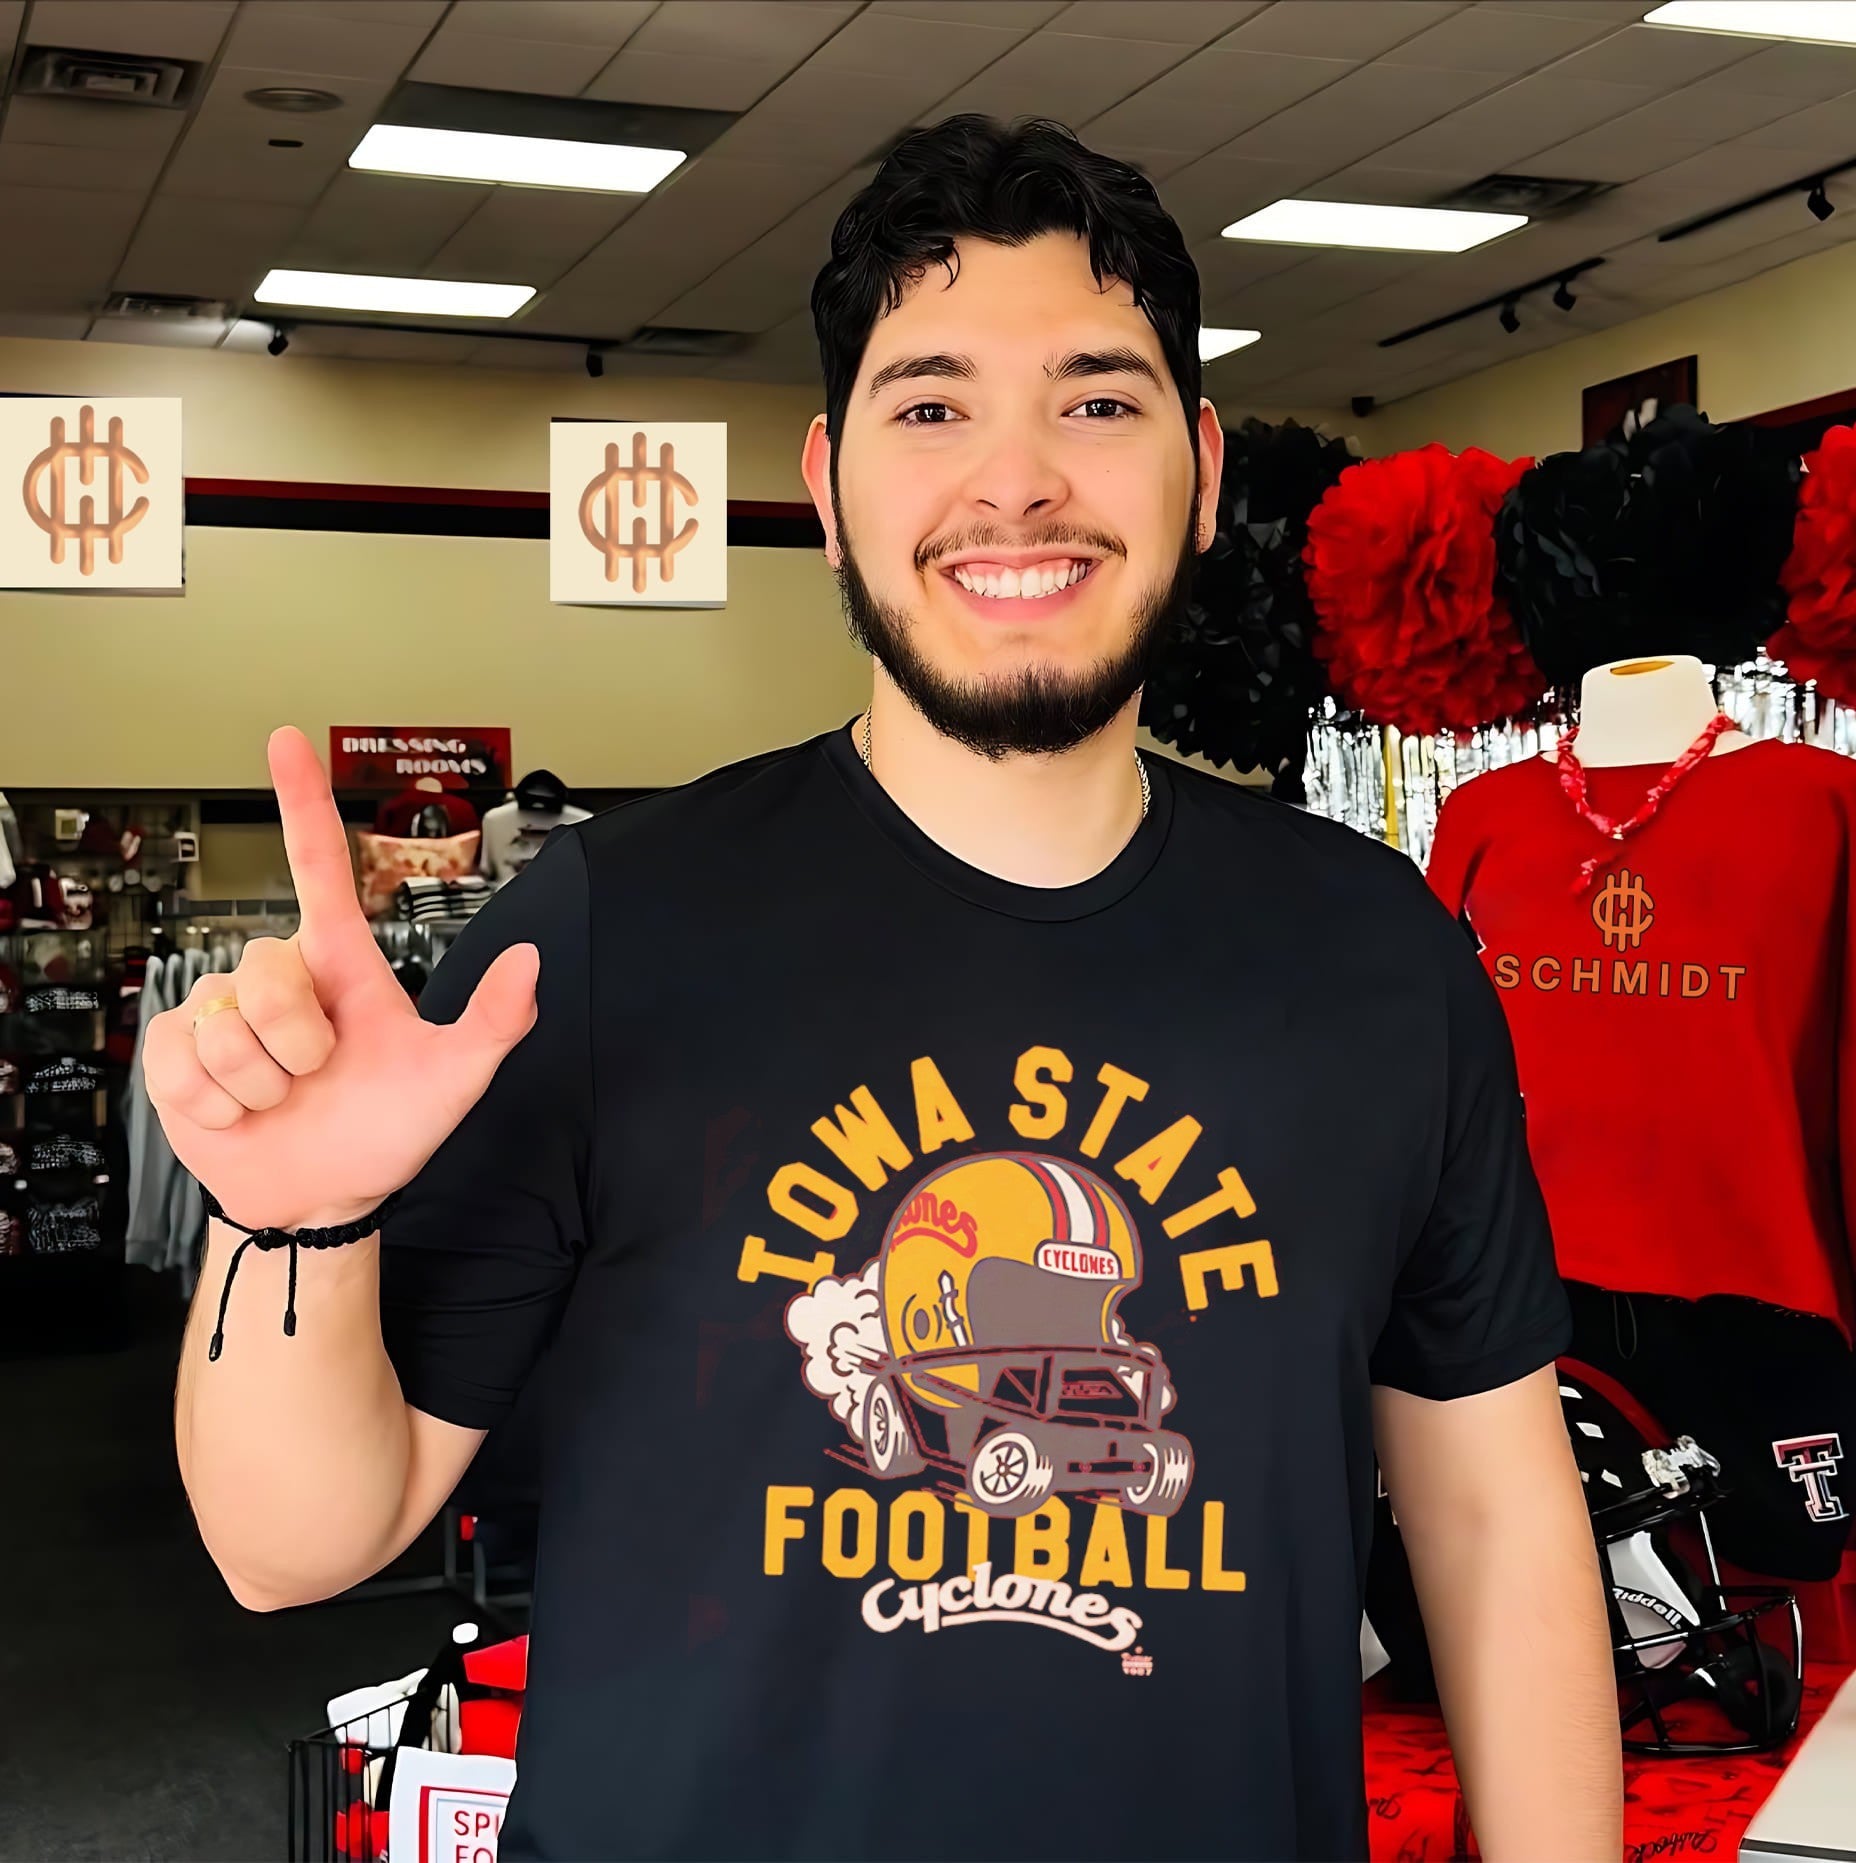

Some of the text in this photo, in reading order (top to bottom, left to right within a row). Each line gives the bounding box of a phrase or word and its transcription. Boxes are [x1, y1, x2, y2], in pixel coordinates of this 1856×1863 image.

[342, 737, 467, 754] DRESSING
[396, 758, 487, 774] ROOMS
[1494, 954, 1746, 1000] SCHMIDT
[737, 1045, 1279, 1310] IOWA STATE
[1043, 1249, 1114, 1274] CYCLONES
[763, 1486, 1246, 1591] FOOTBALL
[861, 1561, 1144, 1651] Cyclones
